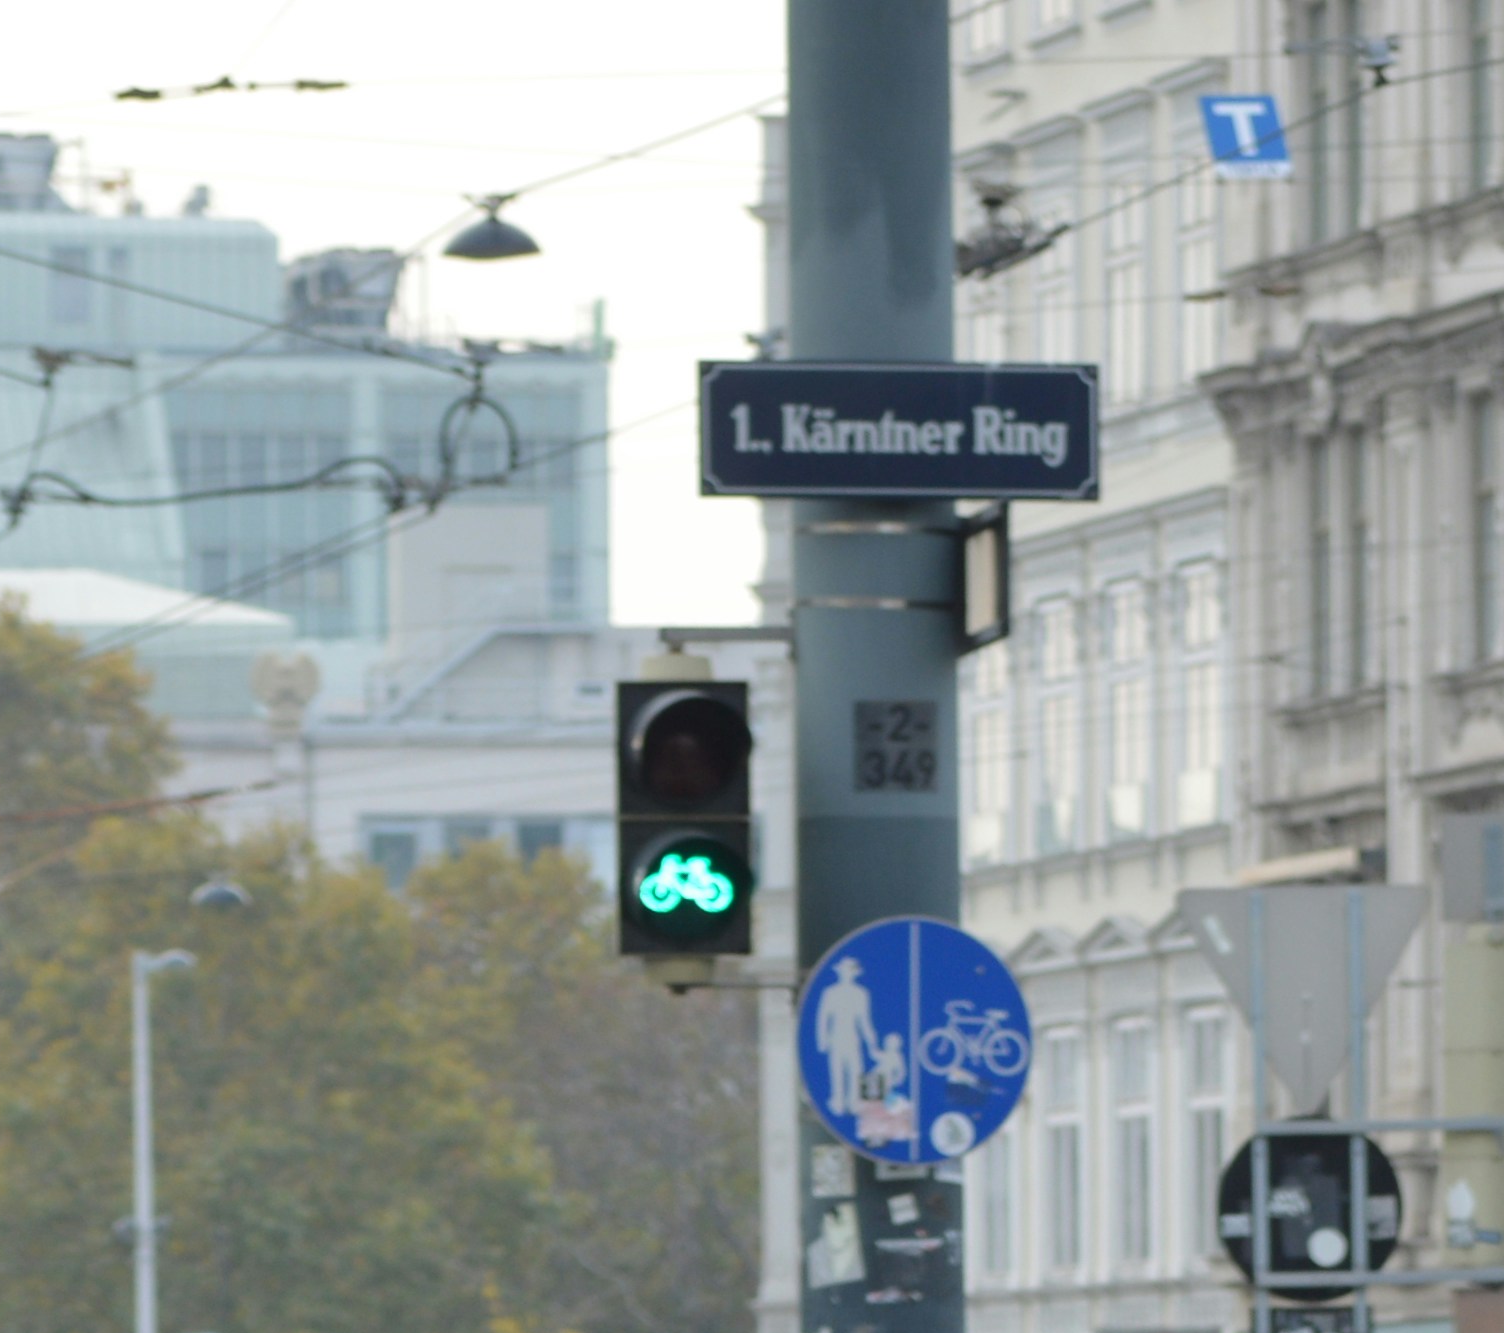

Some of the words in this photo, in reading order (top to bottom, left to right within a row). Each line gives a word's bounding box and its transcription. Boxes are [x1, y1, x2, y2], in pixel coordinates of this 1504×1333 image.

[1212, 102, 1266, 157] T
[780, 403, 965, 455] Kärntner
[972, 406, 1069, 468] Ring
